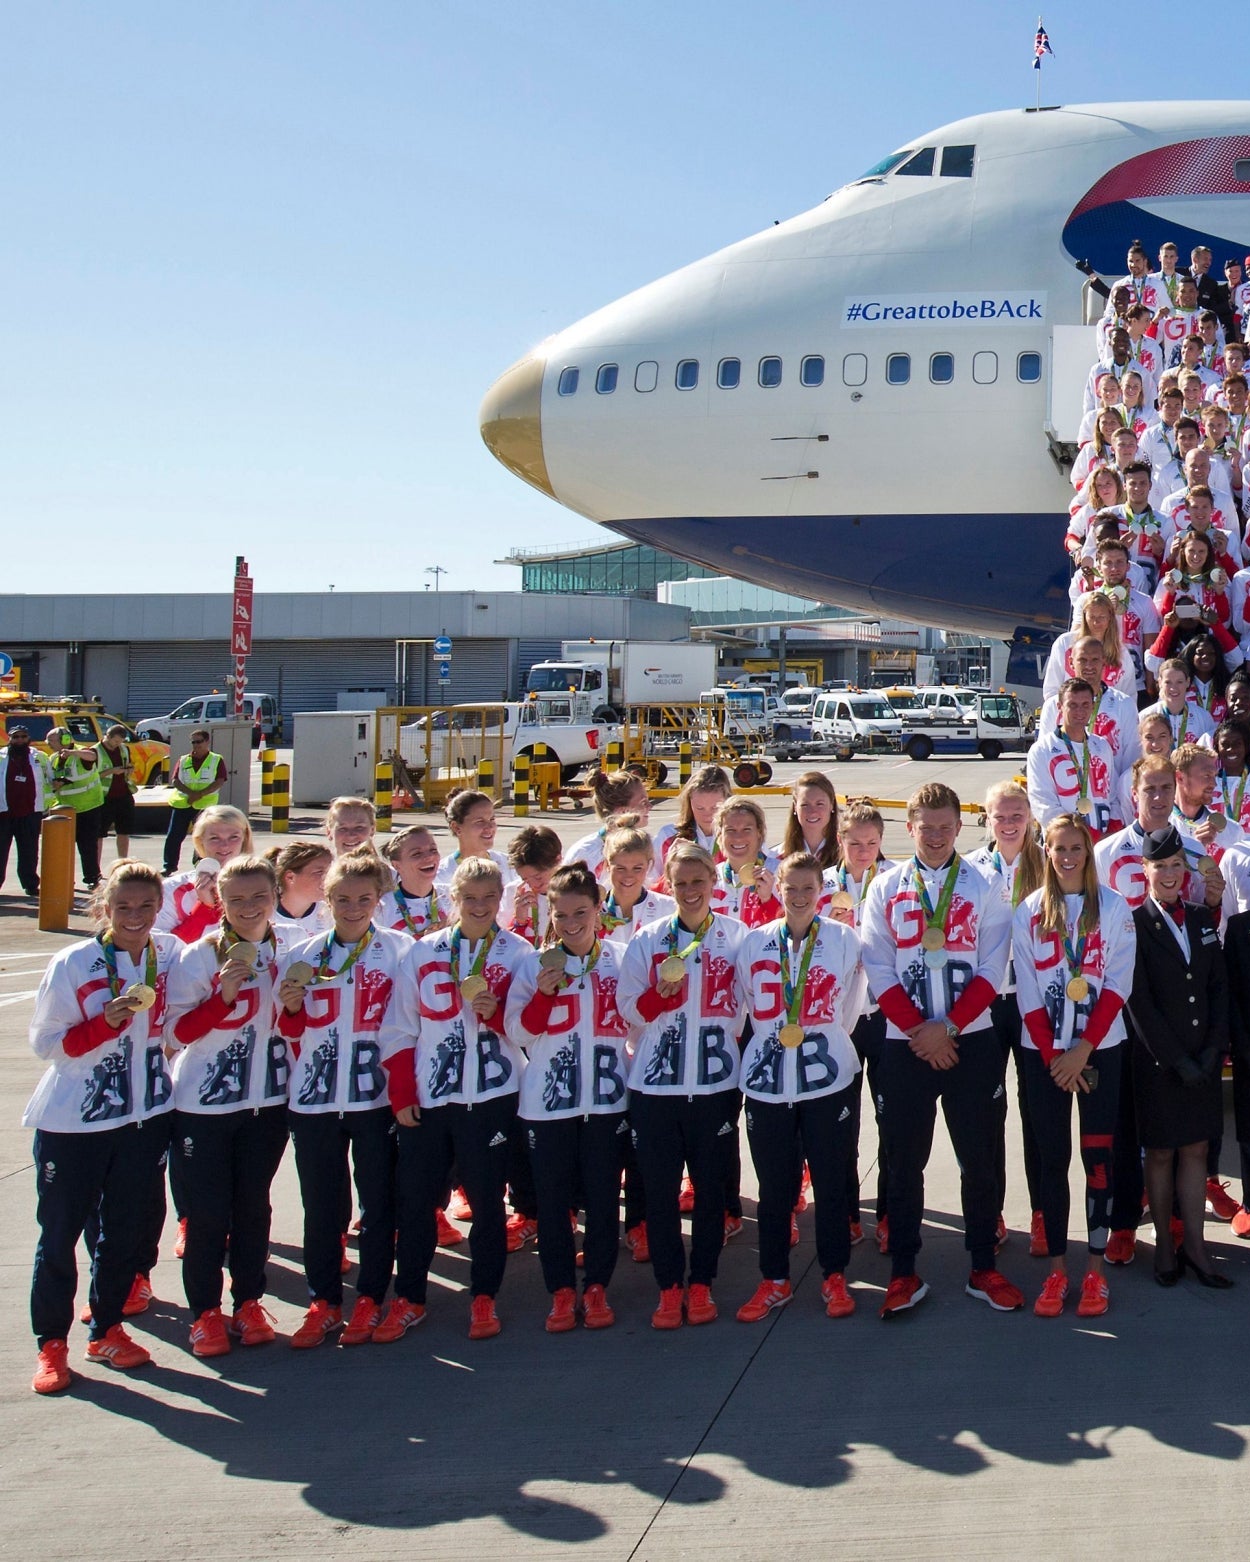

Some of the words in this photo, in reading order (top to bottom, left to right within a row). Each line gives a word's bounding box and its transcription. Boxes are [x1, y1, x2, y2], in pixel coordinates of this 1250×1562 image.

[846, 299, 1043, 322] #GreattobeBAck
[1164, 317, 1187, 340] G
[1049, 754, 1082, 797] G
[885, 891, 927, 949] G
[418, 961, 463, 1021] G
[750, 960, 790, 1022] G
[349, 1040, 387, 1103] B
[476, 1031, 514, 1093] B
[593, 1044, 625, 1106] B
[697, 1025, 734, 1086] B
[796, 1031, 840, 1093] B
